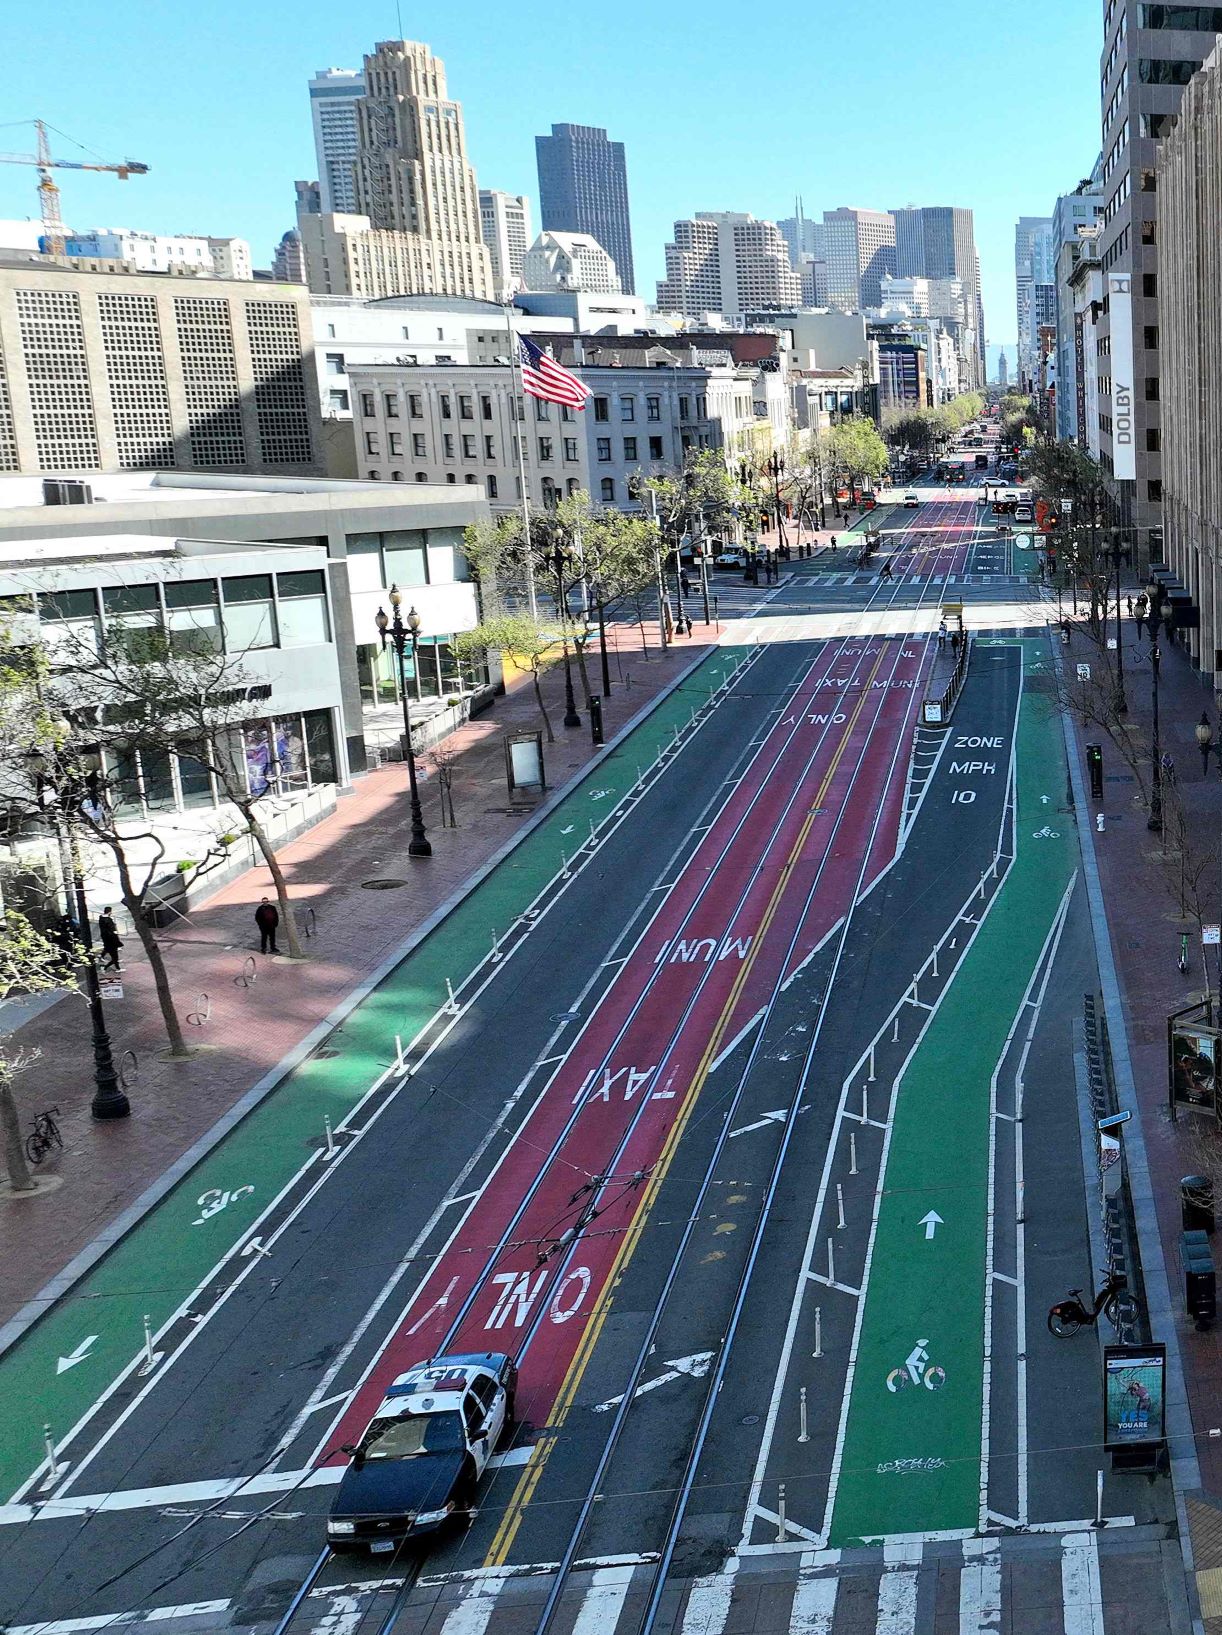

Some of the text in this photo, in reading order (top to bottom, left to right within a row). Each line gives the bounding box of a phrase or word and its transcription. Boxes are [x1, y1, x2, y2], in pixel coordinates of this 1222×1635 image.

[1116, 383, 1132, 445] DOLBY
[815, 677, 861, 687] TAXI
[781, 713, 847, 726] ONLY
[954, 736, 1004, 748] ZONE
[949, 761, 996, 774] MPH
[951, 790, 977, 804] 10
[653, 935, 754, 963] MUNI
[571, 1064, 680, 1105] TAXI
[405, 1266, 591, 1336] ONLY
